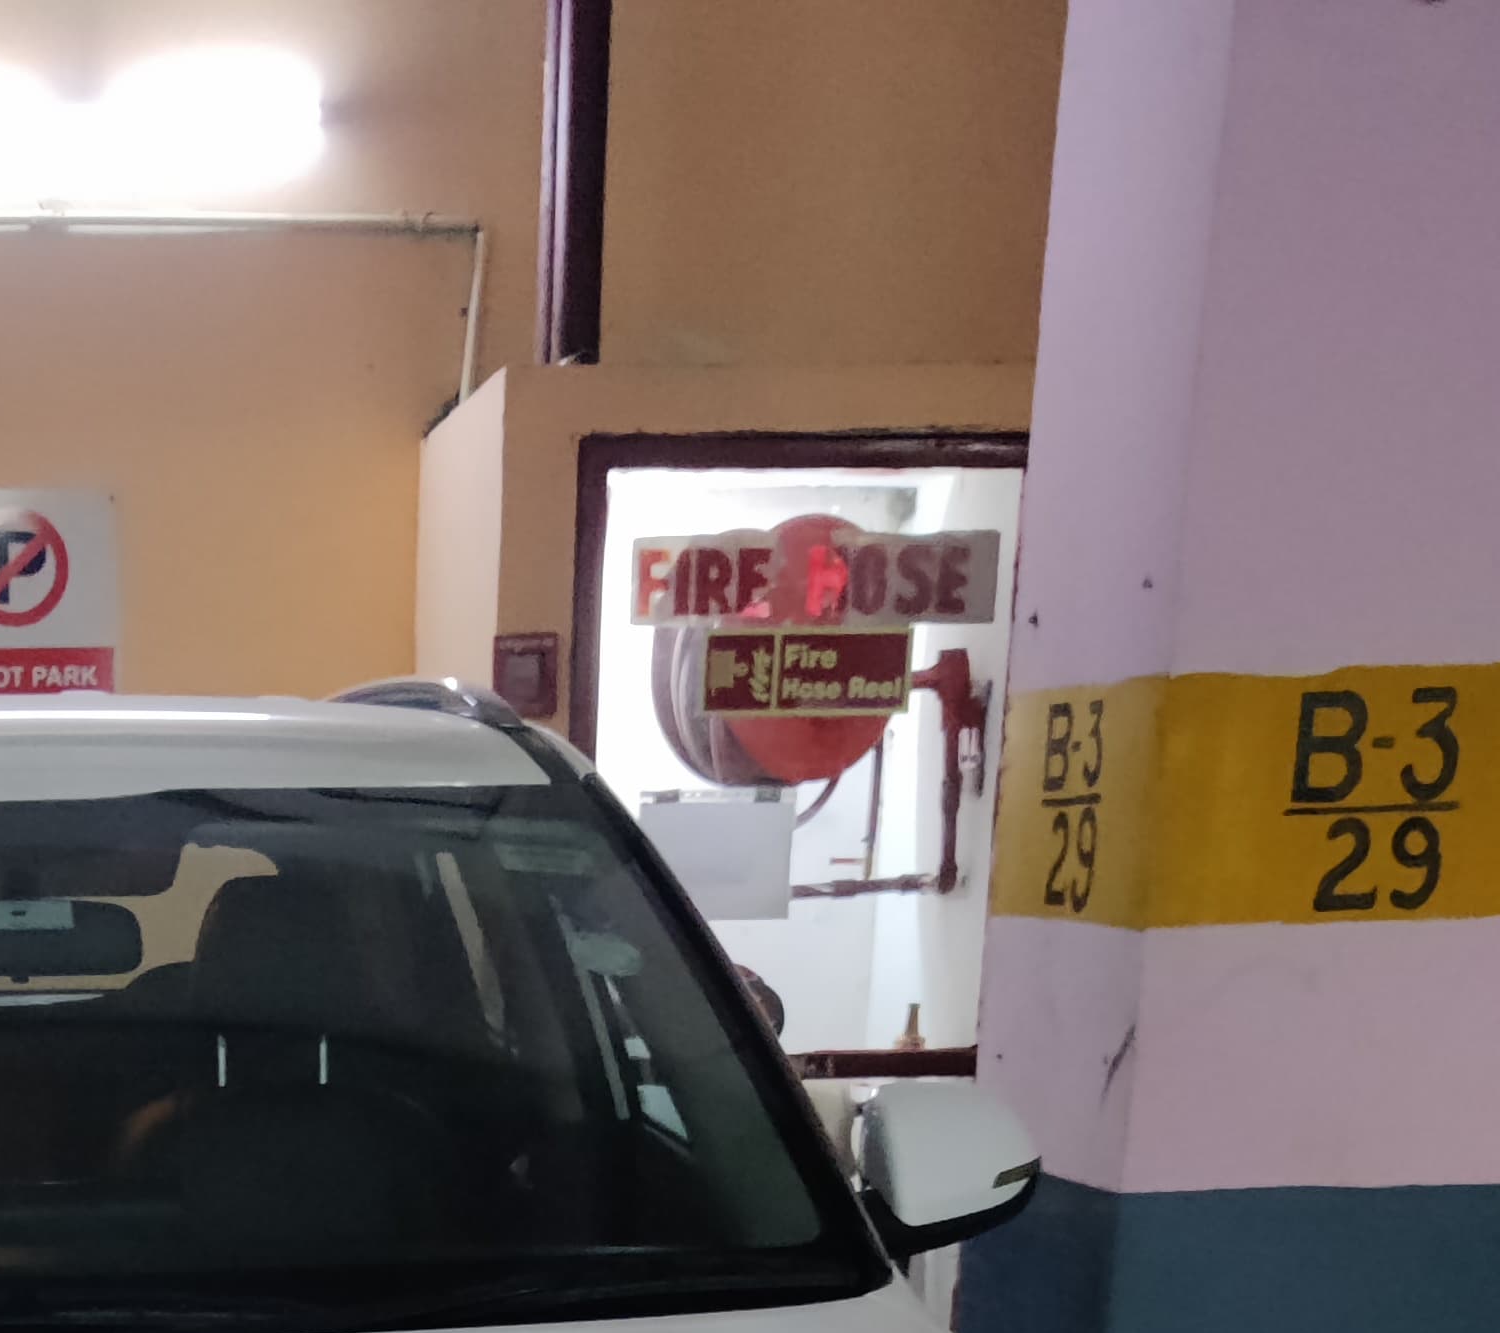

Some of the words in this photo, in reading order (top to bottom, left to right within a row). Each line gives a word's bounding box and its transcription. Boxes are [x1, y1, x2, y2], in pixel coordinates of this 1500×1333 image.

[637, 547, 773, 616] FIRE
[804, 544, 971, 616] HOSE
[32, 664, 98, 687] PARK
[782, 676, 842, 700] Hose
[849, 675, 902, 700] Reel
[784, 644, 838, 669] Fire
[1042, 699, 1104, 792] B-3
[1291, 685, 1460, 803] B-3
[1043, 806, 1097, 913] 29
[1312, 815, 1442, 913] 29
